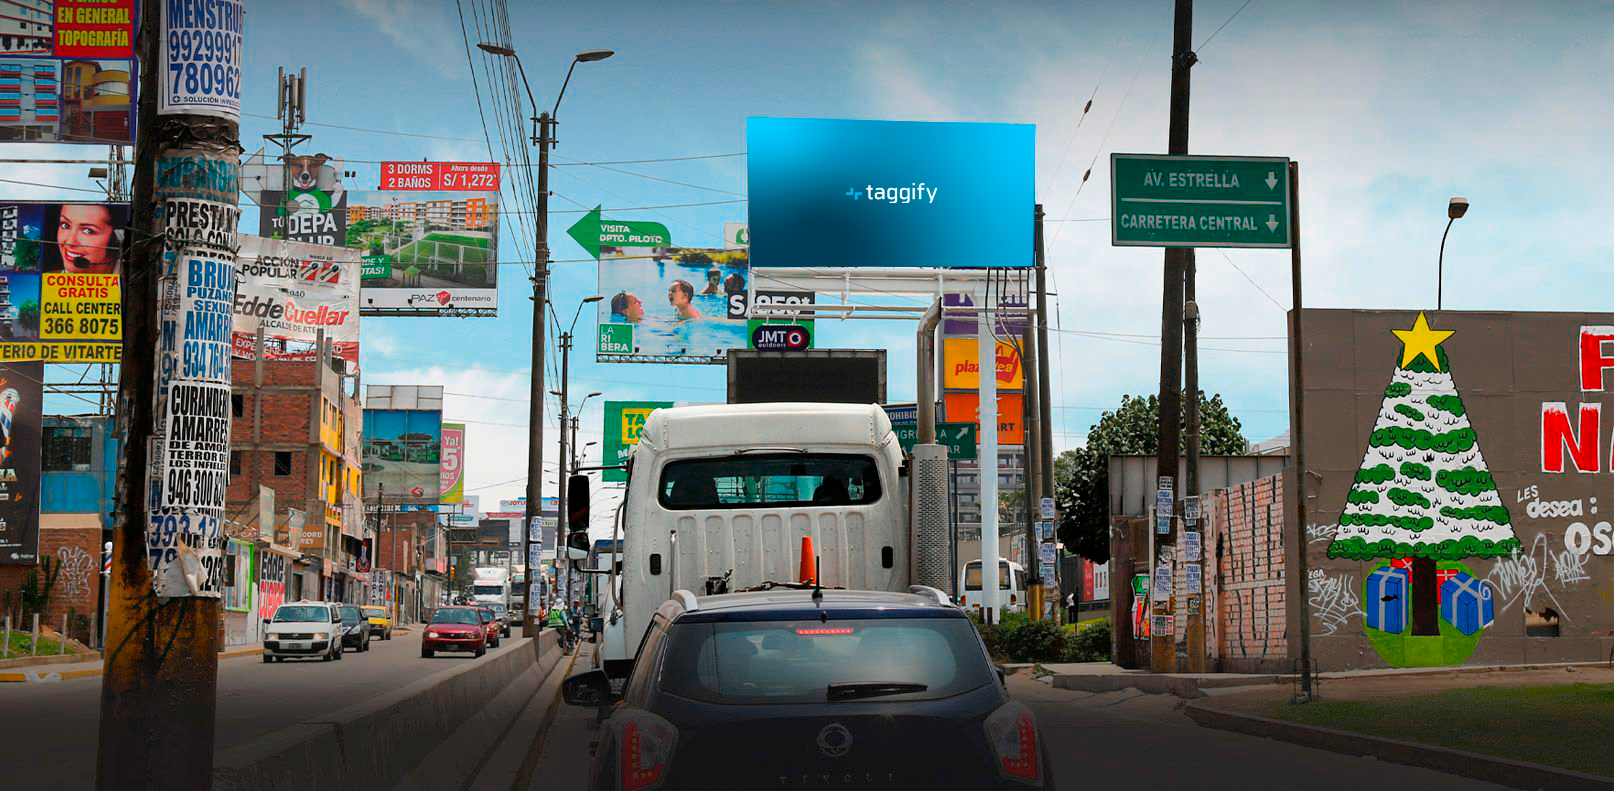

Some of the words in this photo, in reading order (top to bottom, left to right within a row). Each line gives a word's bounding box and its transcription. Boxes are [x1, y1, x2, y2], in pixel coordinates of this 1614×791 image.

[57, 7, 73, 23] EN
[77, 7, 131, 24] GENERAL
[58, 28, 129, 46] TOPOGRAFÍA
[388, 164, 395, 174] 3
[397, 164, 433, 174] DORMS
[388, 177, 395, 188] 2
[397, 176, 431, 188] BAÑOS
[1143, 172, 1165, 187] AV.
[1169, 173, 1240, 188] ESTRELLA
[866, 182, 938, 204] taggify
[288, 213, 338, 235] DEPA
[600, 224, 630, 232] VISITA
[1120, 214, 1196, 230] CARRETERA
[1200, 216, 1257, 230] CENTRAL
[600, 234, 627, 243] DPTO.
[629, 235, 662, 243] PILOTO
[242, 264, 297, 280] POPULAR
[47, 276, 119, 287] CONSULTA
[58, 290, 108, 298] GRATIS
[412, 294, 435, 302] PAZ
[44, 302, 72, 315] CALL
[76, 302, 120, 315] CENTER
[44, 318, 74, 335] 366
[79, 318, 119, 335] 8075
[303, 326, 316, 334] ATE
[601, 325, 615, 334] LA
[758, 330, 787, 343] JMT
[41, 345, 59, 358] DE
[64, 346, 121, 360] VITARTE
[601, 343, 629, 352] BERA
[169, 441, 190, 449] DE
[194, 442, 226, 453] AMOR
[169, 450, 217, 461] TERROR
[169, 460, 191, 468] LOS
[168, 469, 191, 506] 946
[193, 470, 213, 506] 300
[1517, 485, 1538, 503] LES
[1526, 497, 1583, 518] desea
